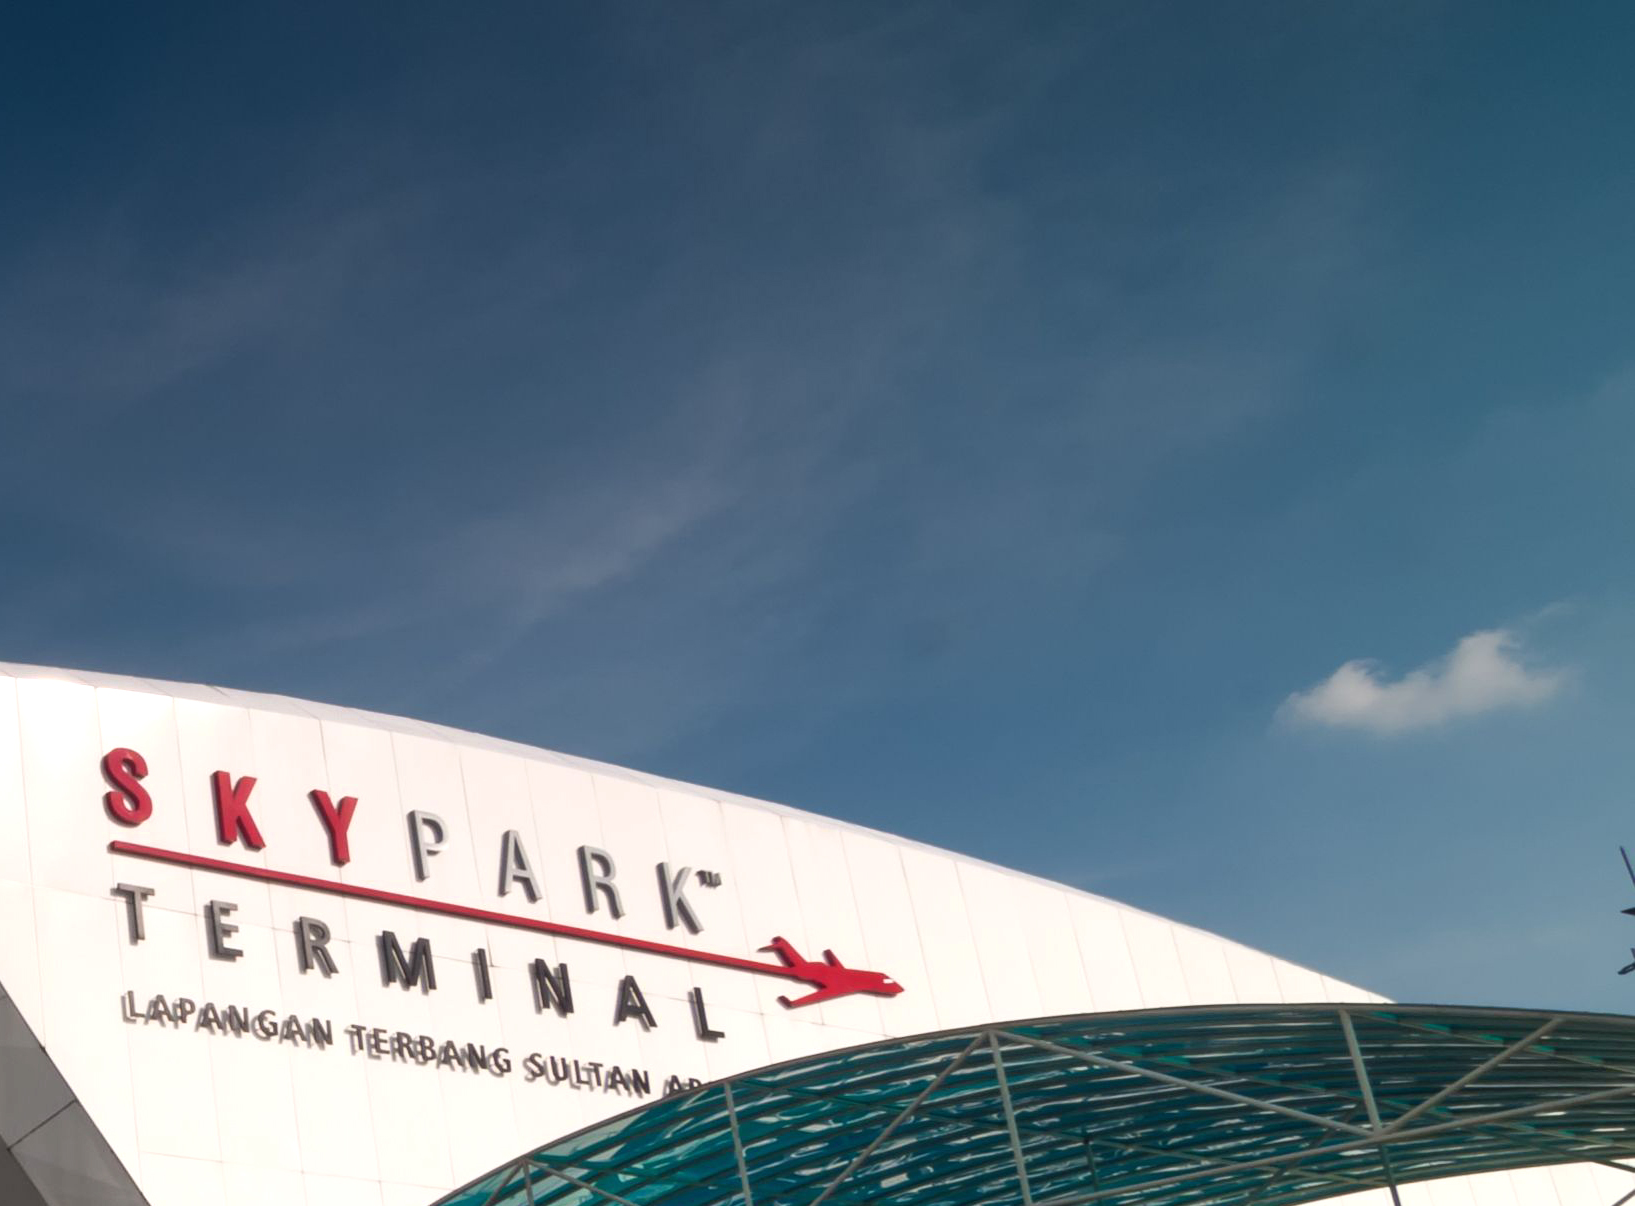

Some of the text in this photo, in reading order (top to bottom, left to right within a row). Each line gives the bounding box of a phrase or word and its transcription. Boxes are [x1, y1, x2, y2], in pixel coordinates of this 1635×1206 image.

[112, 883, 726, 1041] TERMINAL
[122, 990, 333, 1050] LAPANGAN
[346, 1024, 511, 1076] TERBANG
[526, 1053, 651, 1098] SULTAN
